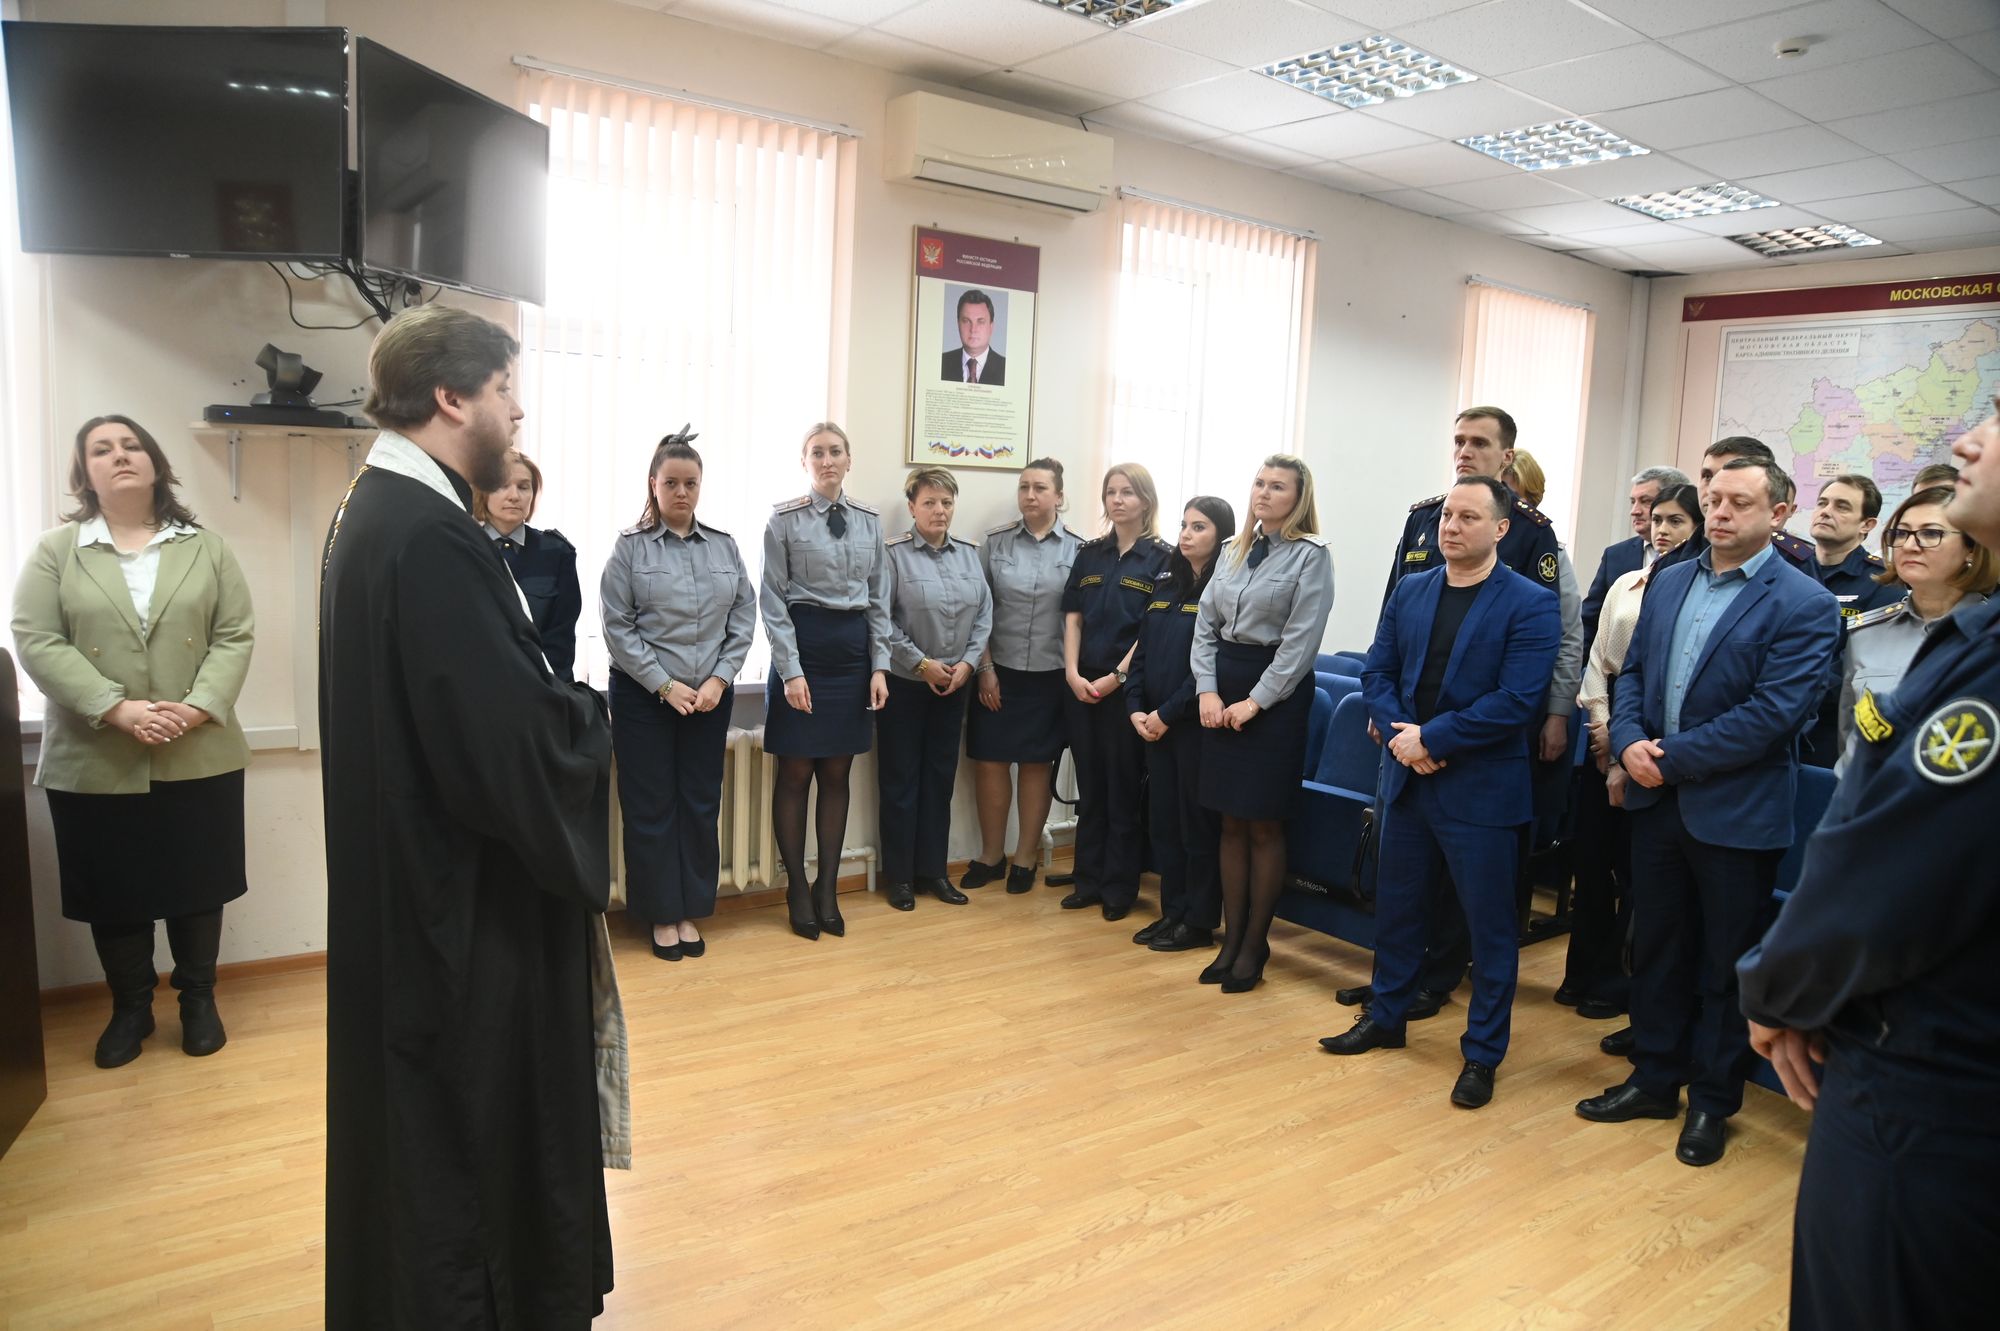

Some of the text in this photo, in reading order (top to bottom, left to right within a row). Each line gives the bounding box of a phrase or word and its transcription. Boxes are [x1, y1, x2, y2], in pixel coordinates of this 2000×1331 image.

[1889, 282, 1993, 302] МОСКОВСКАЯ
[1731, 336, 1779, 344] ЦЕНТРАЛЬНЫЙ
[1782, 333, 1832, 341] ФЕДЕРАЛЬНЫЙ
[1740, 342, 1800, 350] МОСКОВСКАЯ
